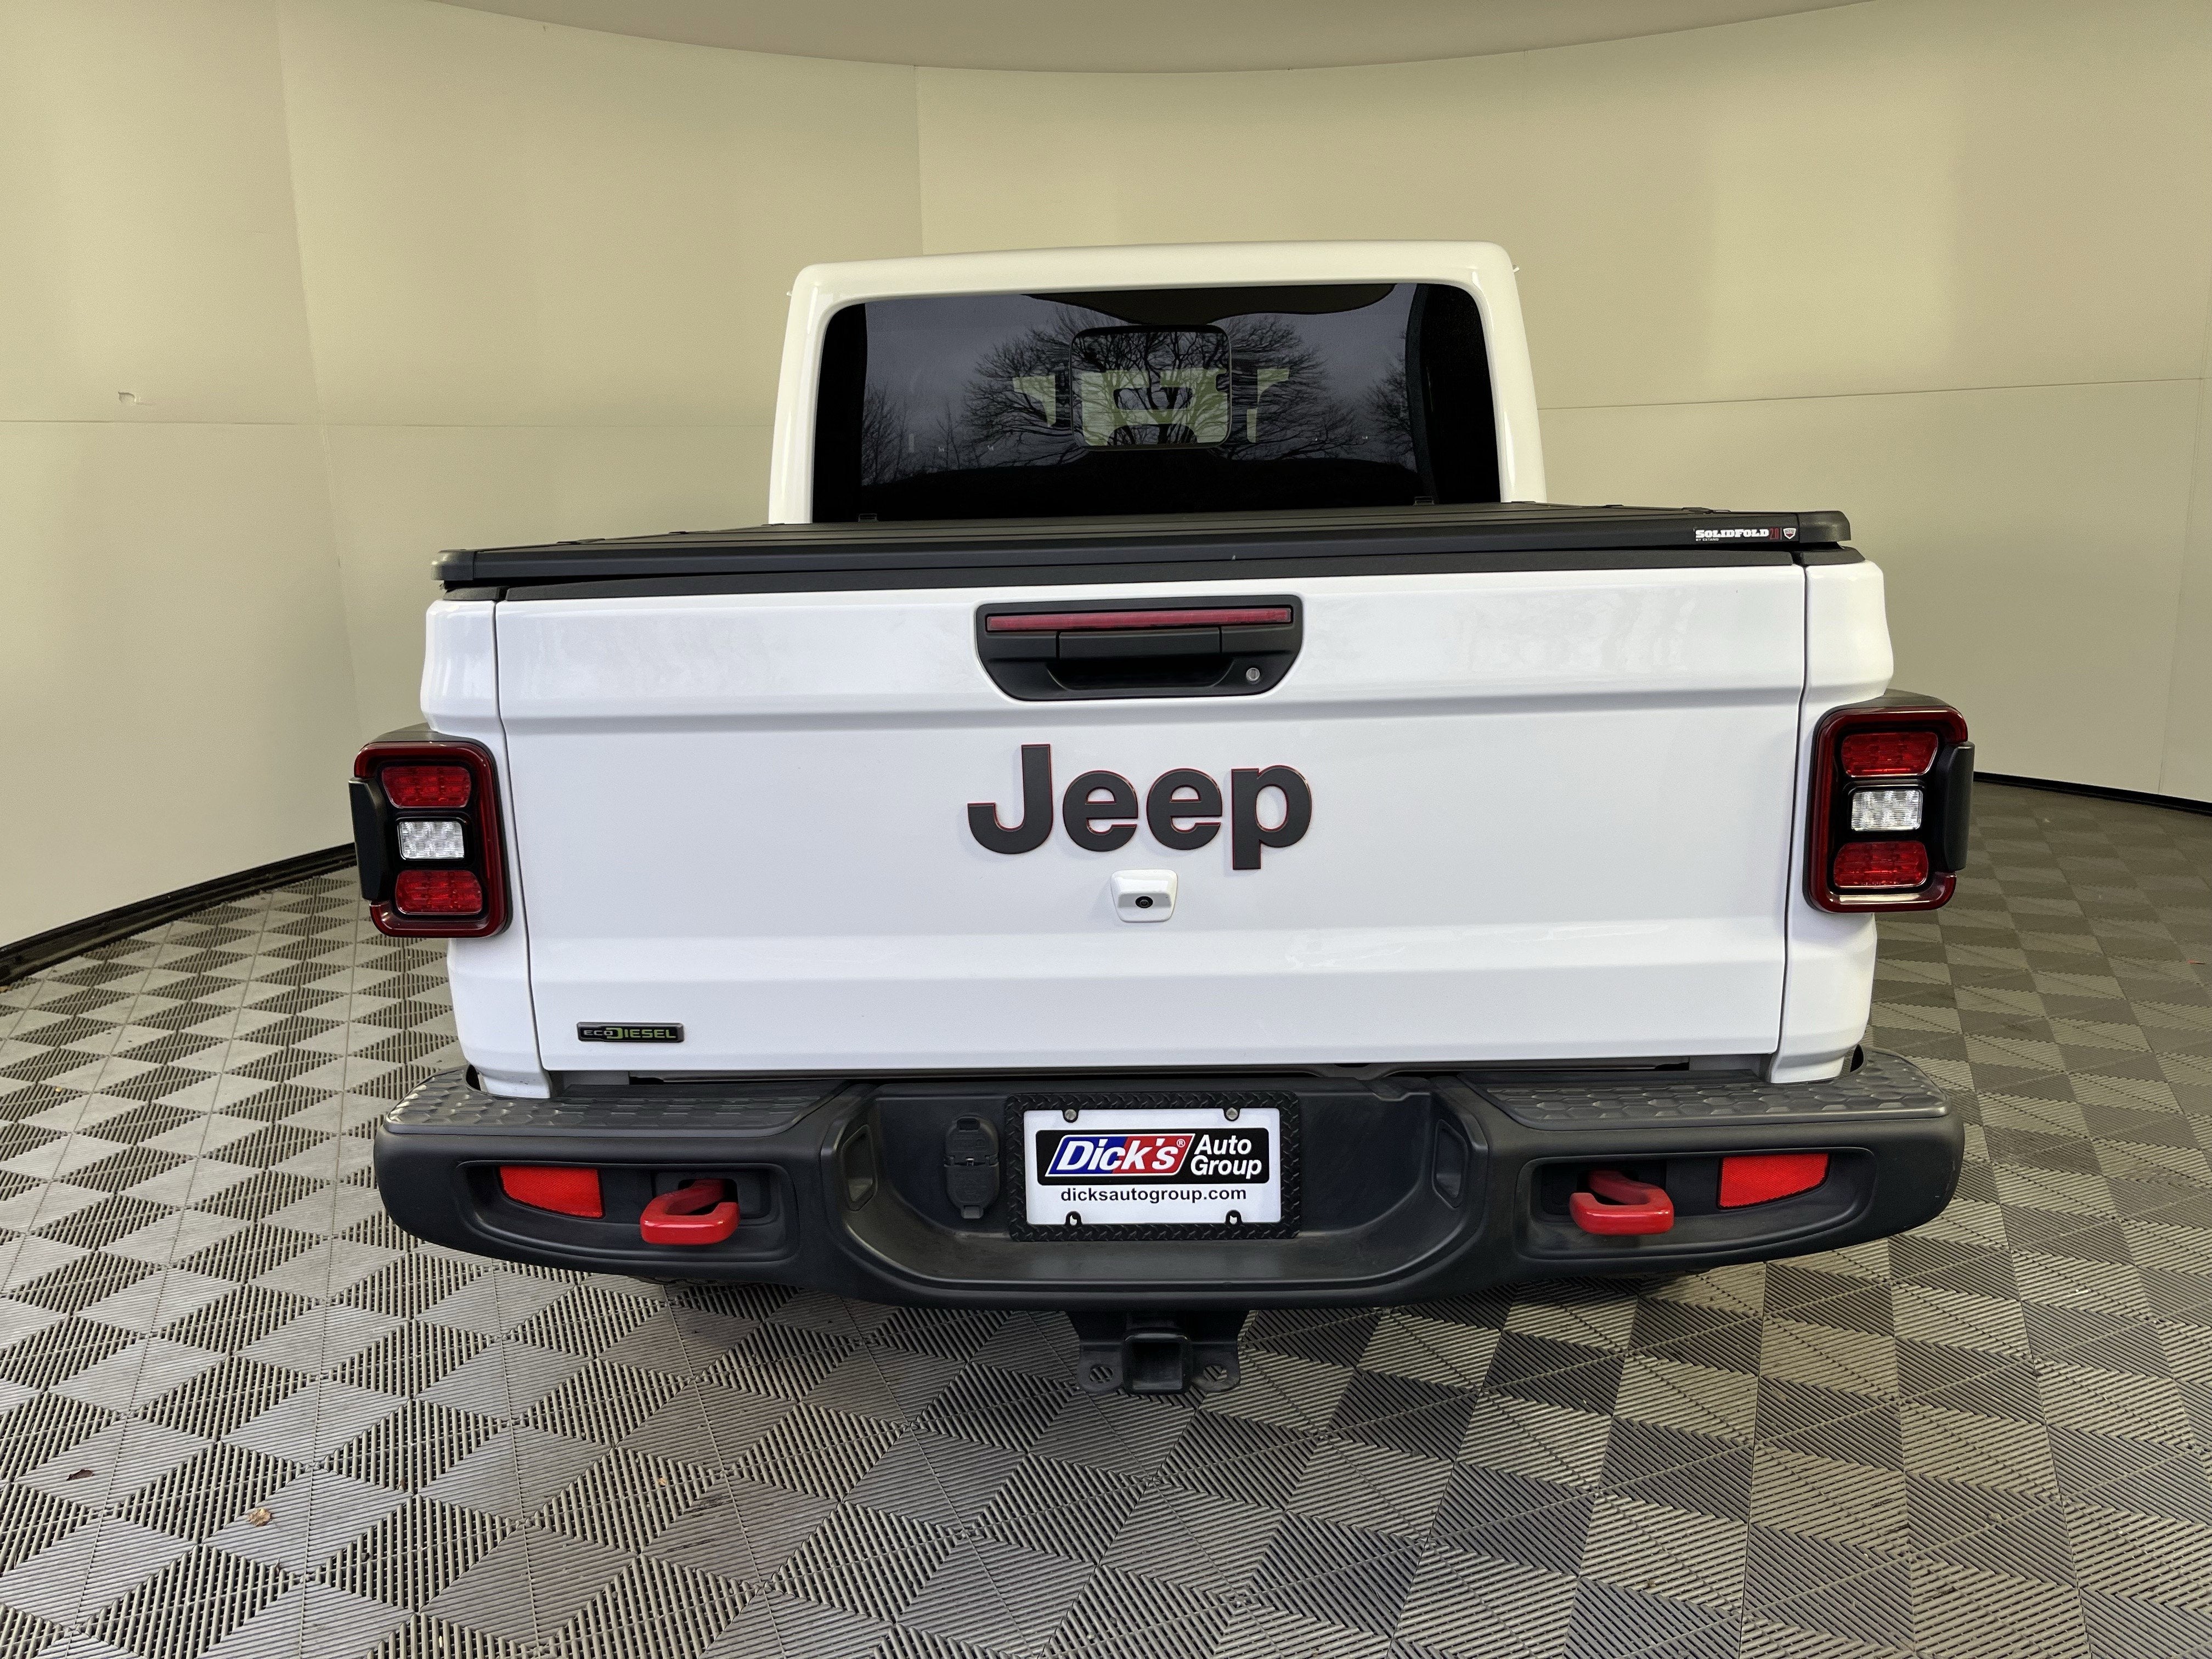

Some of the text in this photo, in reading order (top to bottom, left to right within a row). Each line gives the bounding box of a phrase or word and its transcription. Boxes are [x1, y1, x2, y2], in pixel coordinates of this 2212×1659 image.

[1695, 529, 1769, 538] SOLIDFOLD
[967, 743, 1312, 870] Jeep
[1194, 1134, 1252, 1155] Auto
[1190, 1155, 1262, 1180] Group
[1060, 1187, 1247, 1203] dicksautogroup.com
